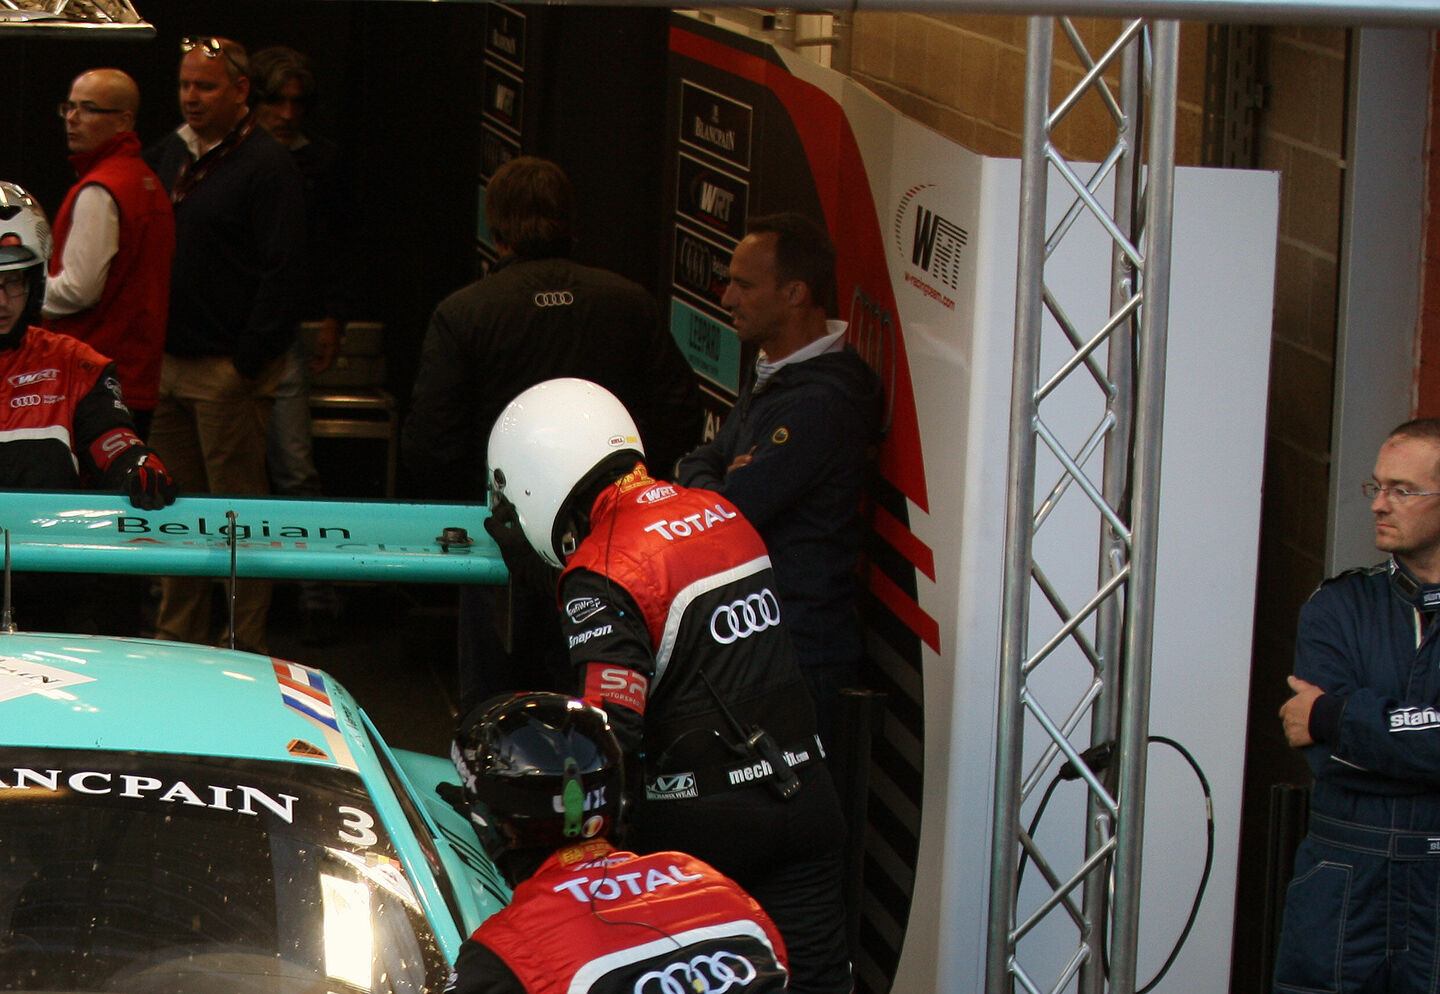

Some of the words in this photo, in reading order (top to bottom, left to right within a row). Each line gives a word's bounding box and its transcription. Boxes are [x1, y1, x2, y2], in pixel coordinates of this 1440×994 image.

[699, 181, 735, 222] WRT
[645, 485, 676, 501] WRT
[117, 516, 351, 543] Belgian
[643, 503, 737, 541] TOTAL
[338, 806, 378, 847] 3
[553, 865, 703, 903] TOTAL
